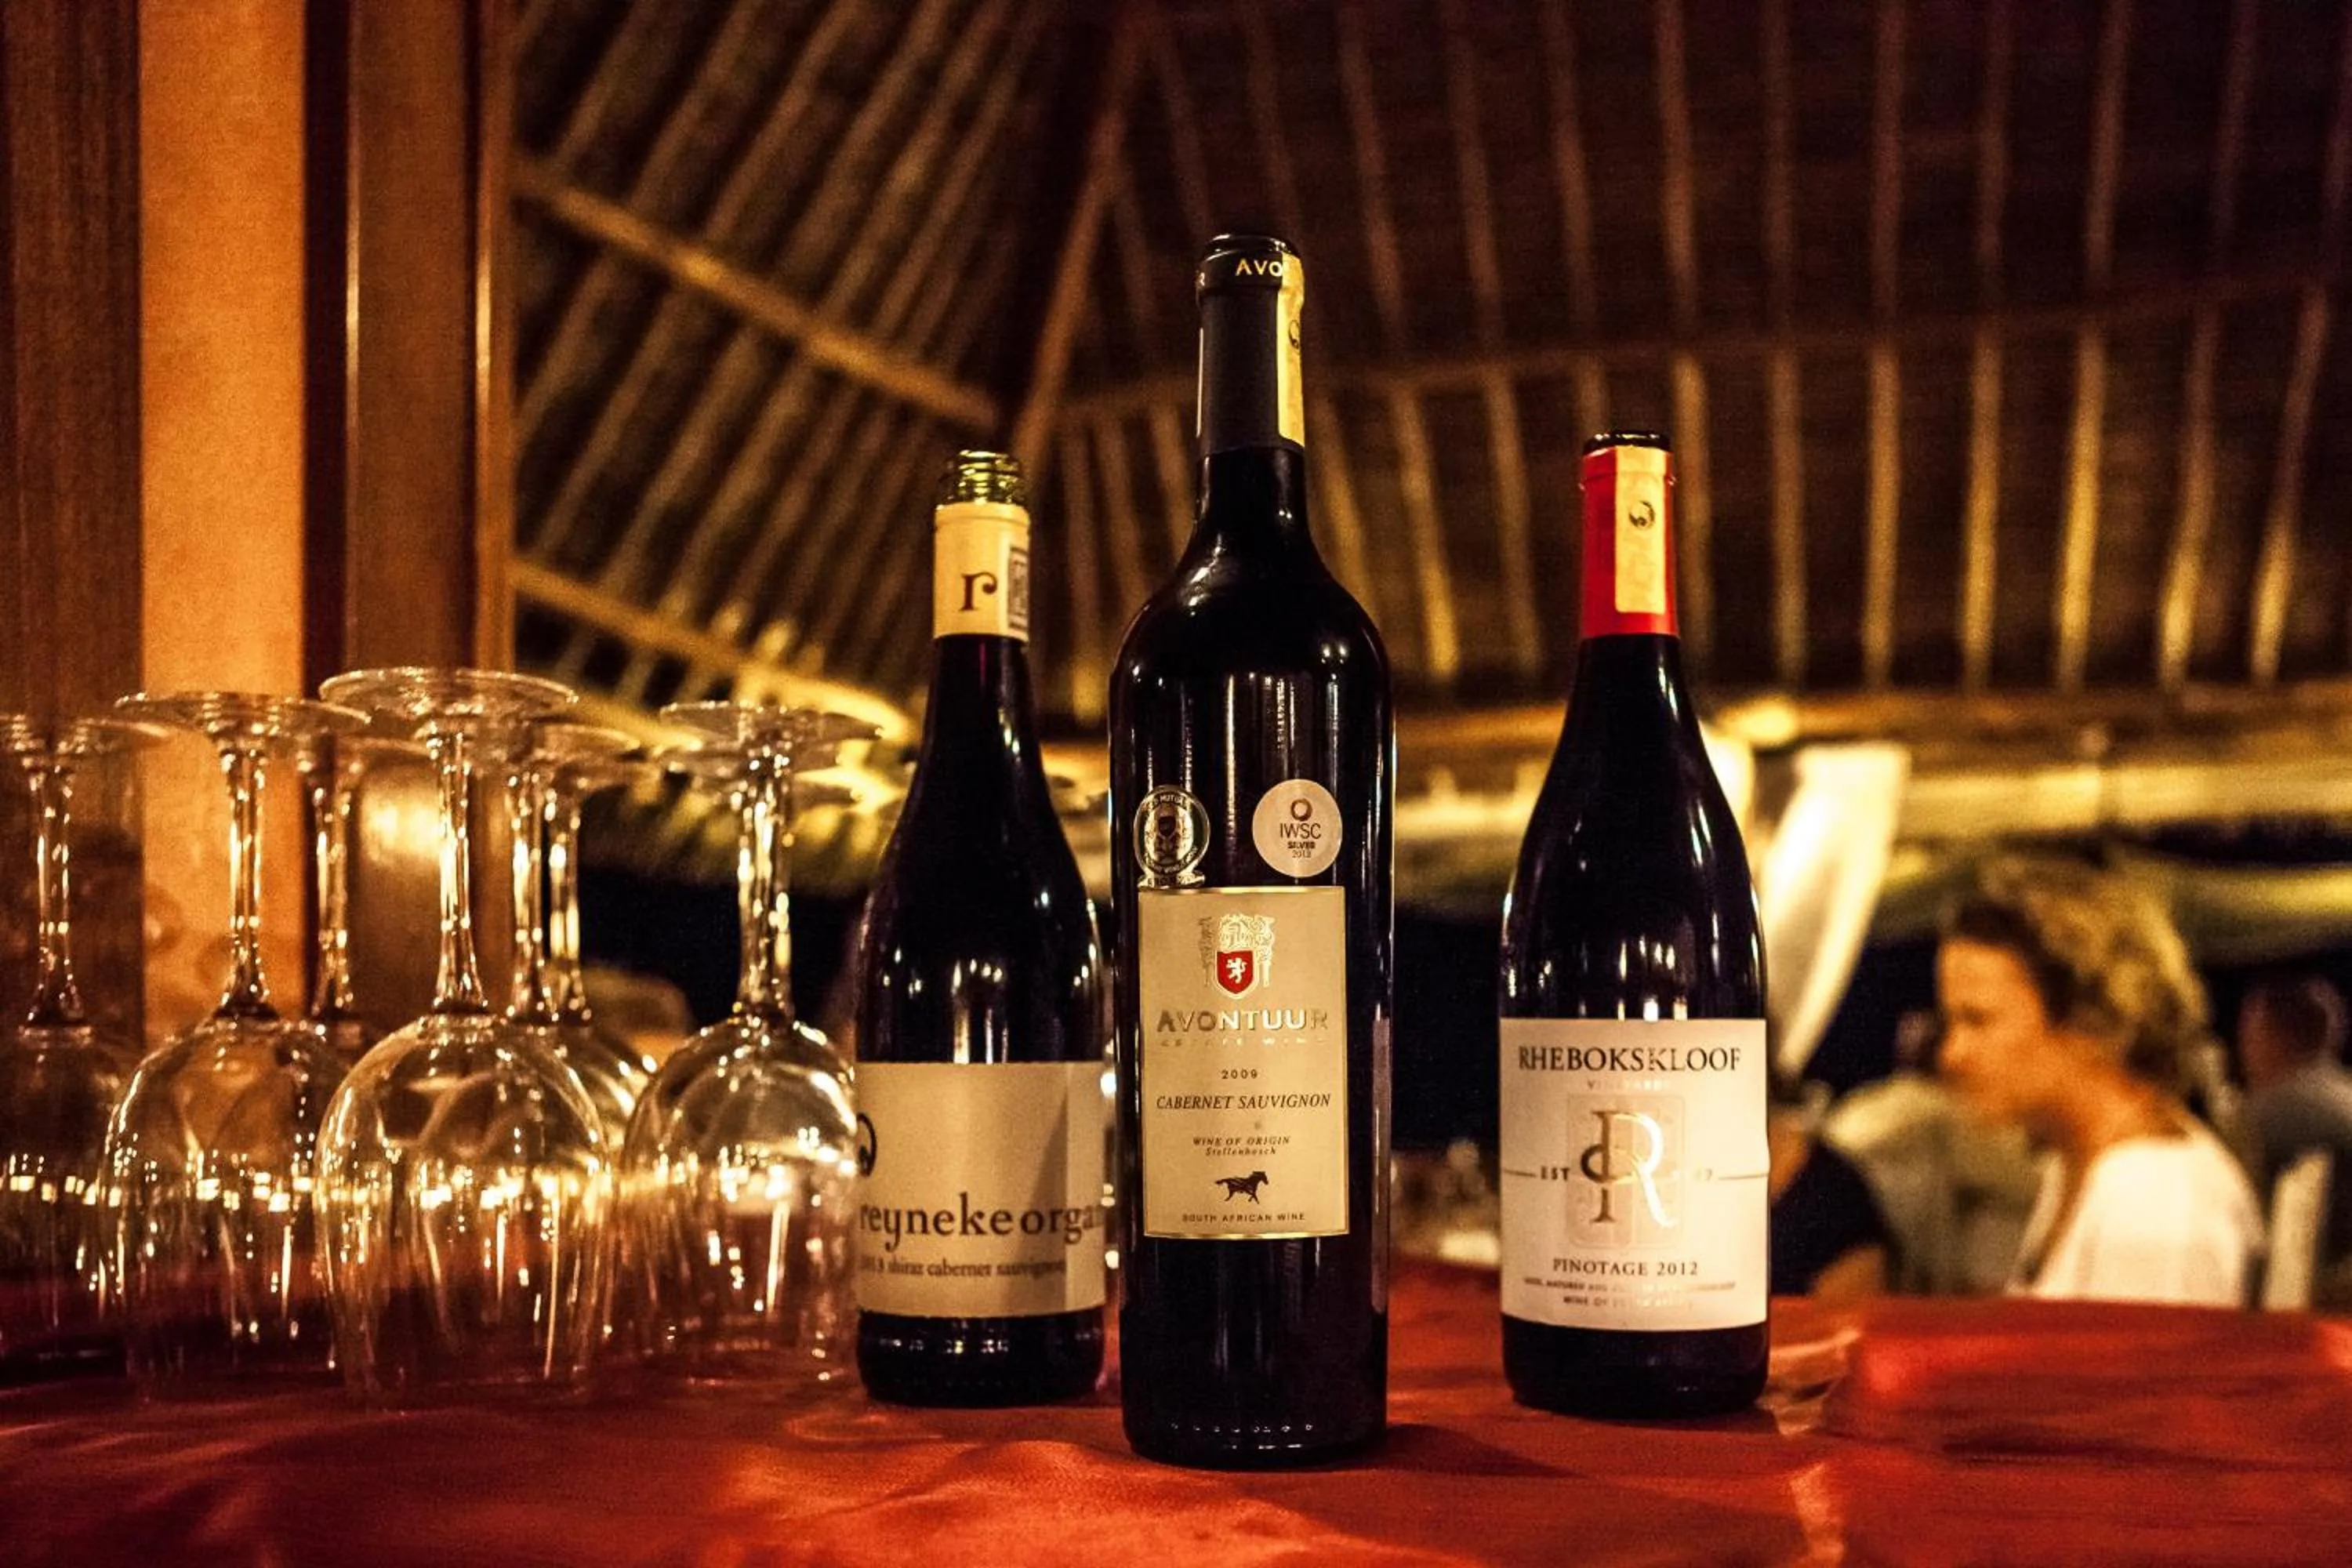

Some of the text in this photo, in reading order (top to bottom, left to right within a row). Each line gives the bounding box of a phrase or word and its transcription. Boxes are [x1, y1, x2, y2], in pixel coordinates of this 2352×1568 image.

[958, 572, 998, 611] r
[1279, 822, 1322, 840] IWSC
[1287, 840, 1316, 849] SILVER
[1156, 1008, 1328, 1033] AVONTUUR
[1518, 1046, 1741, 1072] RHEBOKSKLOOF
[1221, 1069, 1258, 1080] 2009
[1156, 1094, 1330, 1109] CABERNET SAUVIGNON
[1192, 1137, 1290, 1146] WINE OF ORIGIN
[1205, 1146, 1276, 1156] Stellenbosch
[1541, 1166, 1570, 1181] EST
[1182, 1212, 1305, 1222] SOUTH AFRICAN WINE
[927, 1258, 991, 1277] cabernet
[1552, 1258, 1698, 1276] PINOTAGE 2012
